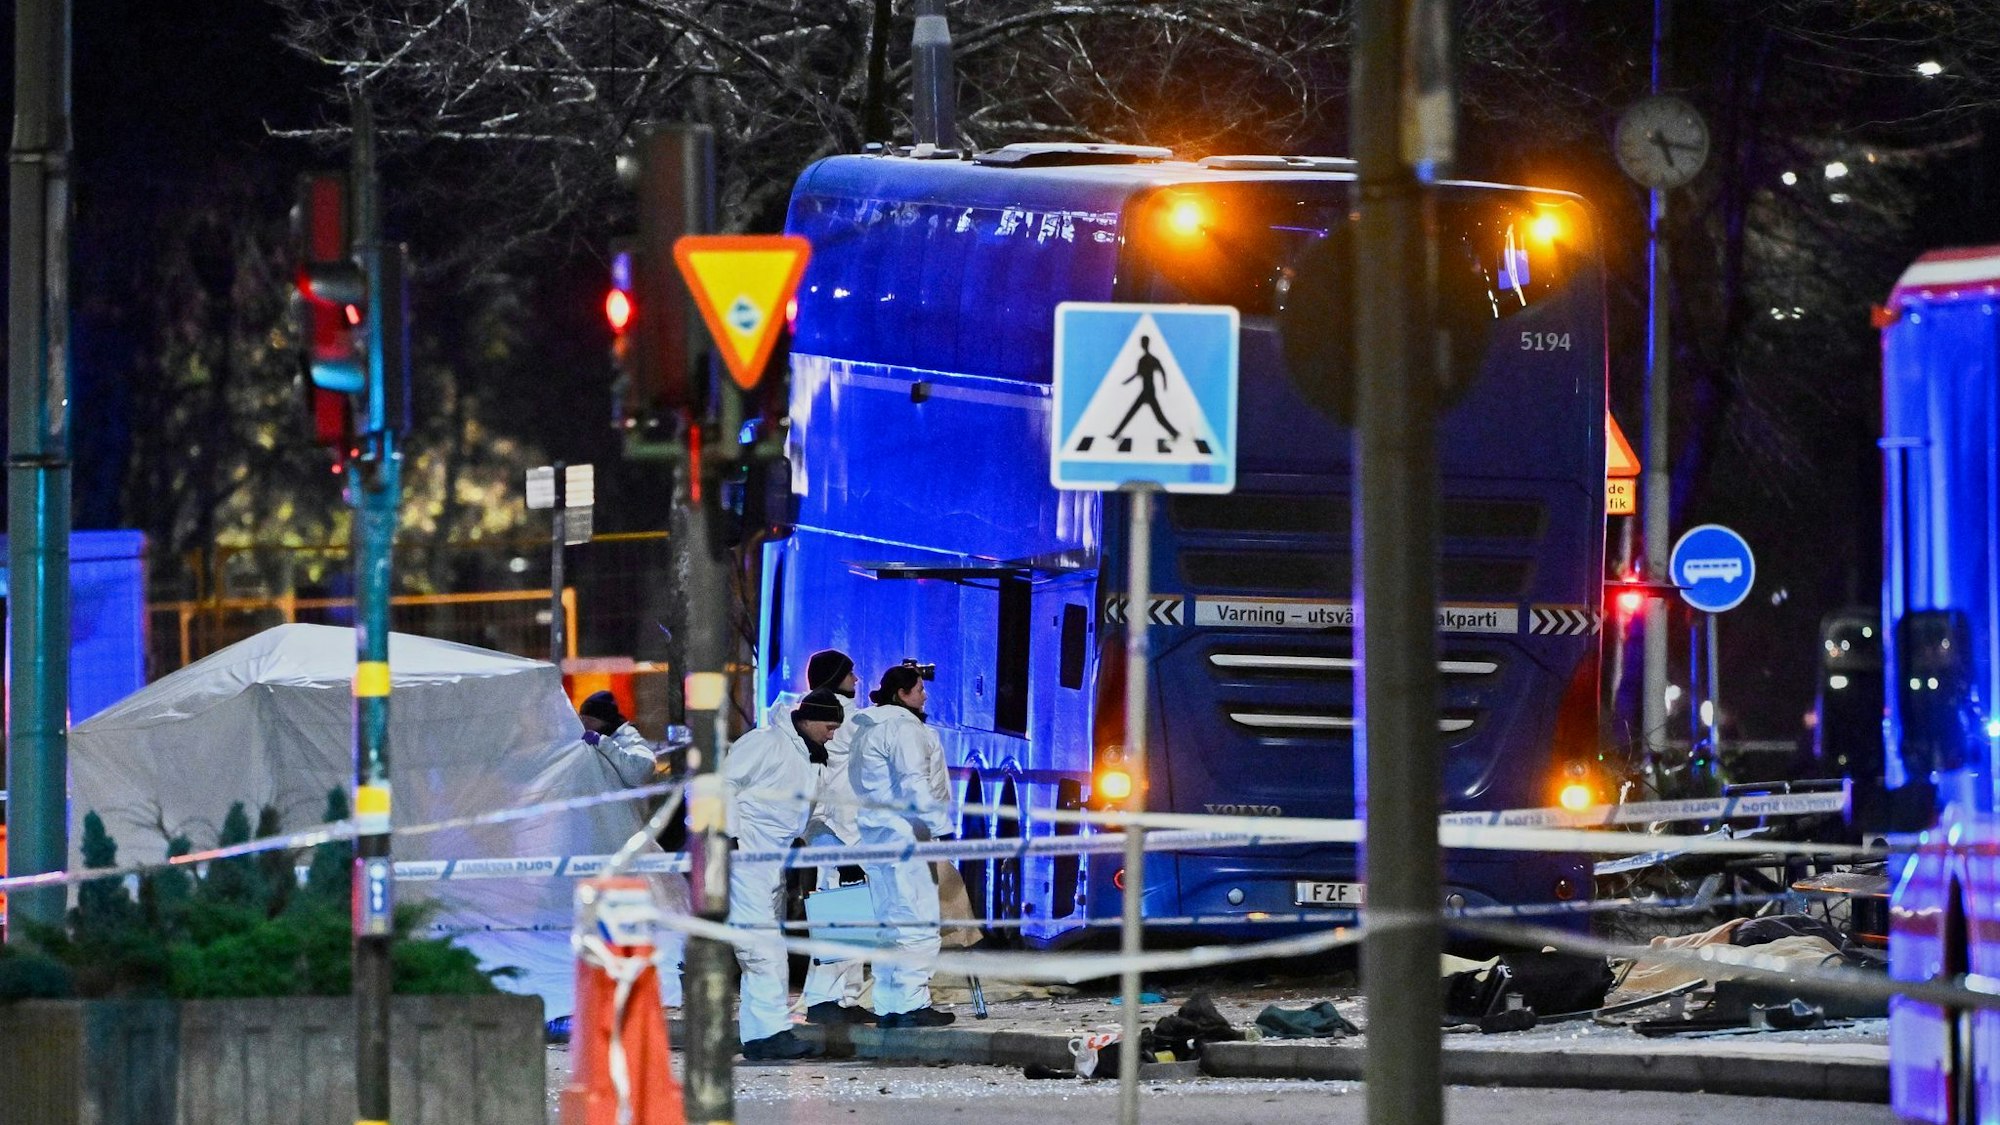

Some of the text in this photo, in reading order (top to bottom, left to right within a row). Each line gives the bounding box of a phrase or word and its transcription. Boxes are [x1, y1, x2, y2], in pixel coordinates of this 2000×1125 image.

[1520, 331, 1572, 352] 5194
[1217, 604, 1286, 625] Varning
[1312, 884, 1349, 902] FZF
